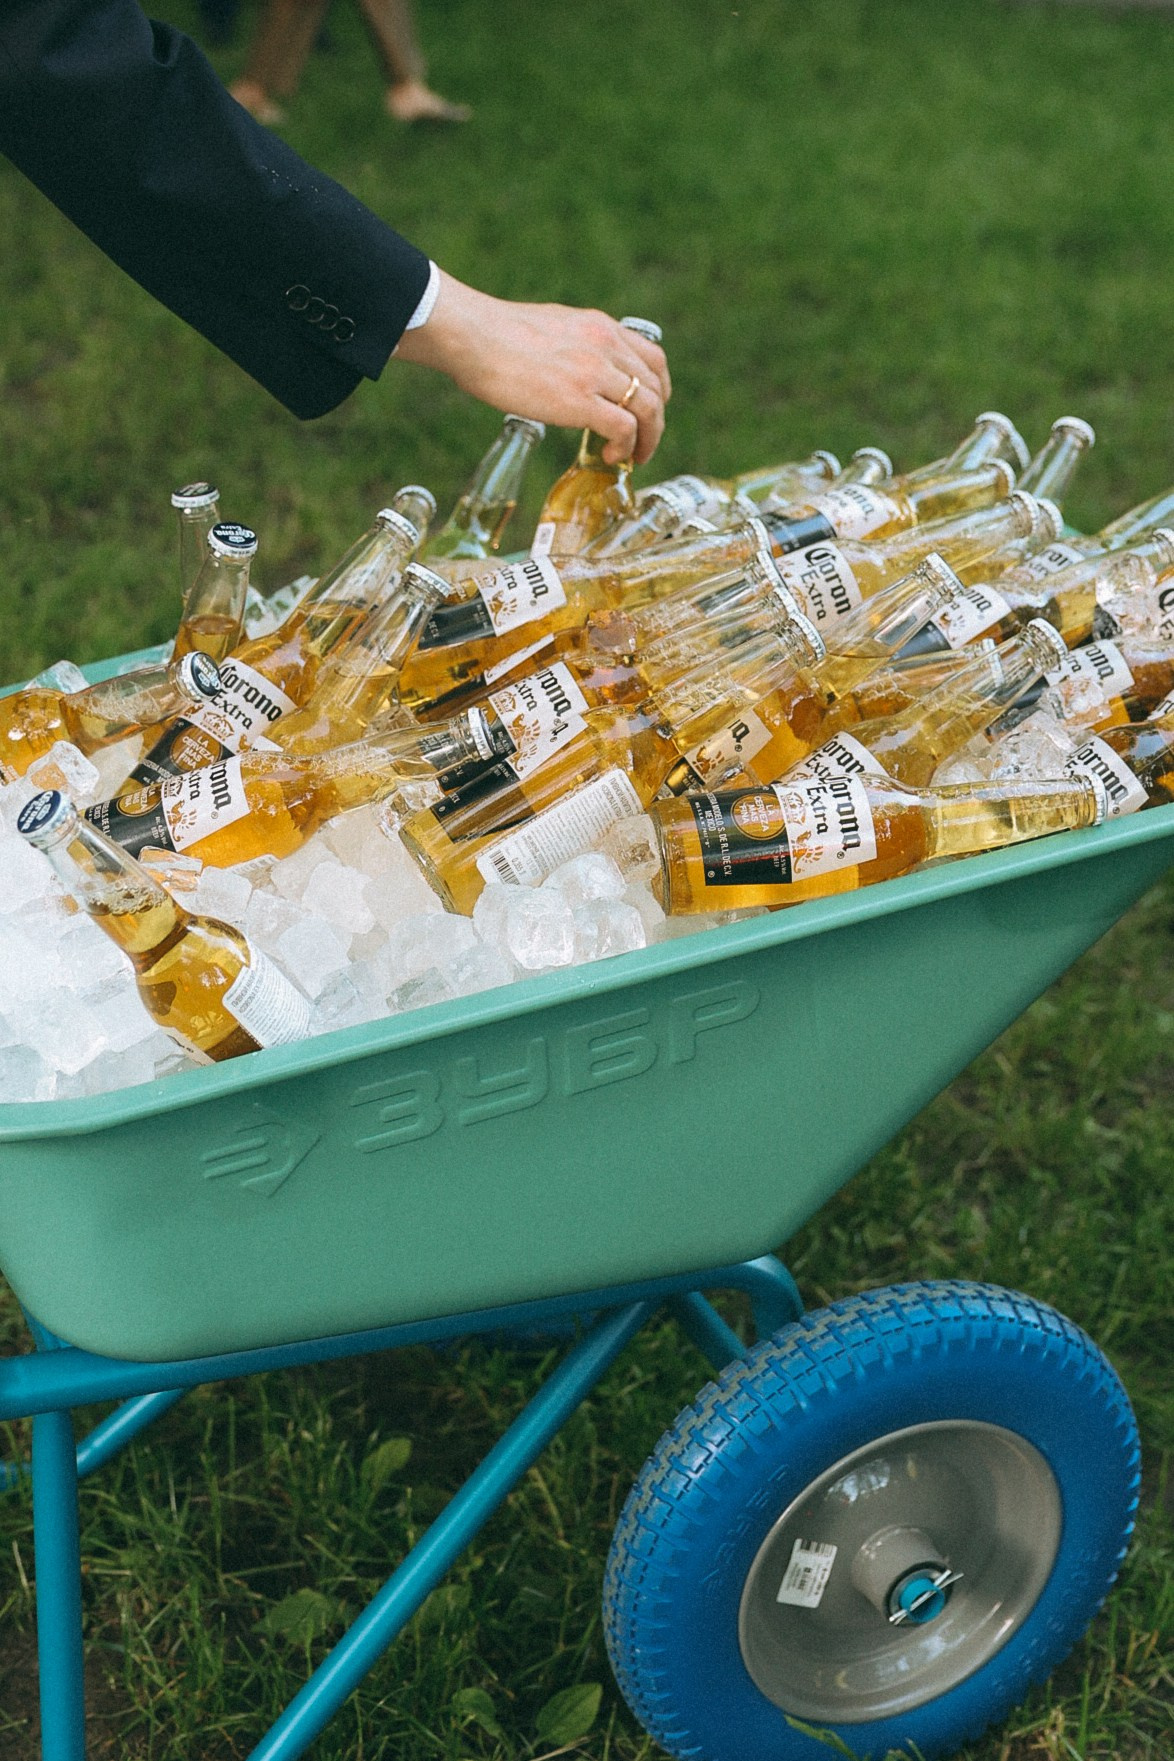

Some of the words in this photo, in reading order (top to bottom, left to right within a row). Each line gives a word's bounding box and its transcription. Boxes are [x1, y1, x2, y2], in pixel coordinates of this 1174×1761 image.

[520, 559, 548, 599] rona
[800, 568, 827, 621] Extra
[805, 547, 852, 615] Coron
[210, 689, 253, 730] Extra
[514, 676, 538, 711] xtra
[535, 669, 572, 717] rona
[182, 736, 215, 763] CERVEZA
[189, 746, 202, 763] MAS
[197, 736, 209, 748] LA
[822, 735, 866, 773] oron
[210, 759, 232, 810] rona
[739, 803, 750, 824] FINA
[748, 804, 760, 823] MAS
[753, 795, 769, 832] CERVEZA
[764, 804, 775, 816] LA
[807, 784, 829, 835] Extra
[719, 833, 727, 842] DE
[722, 856, 730, 865] DE
[351, 979, 760, 1154] ЗУБР
